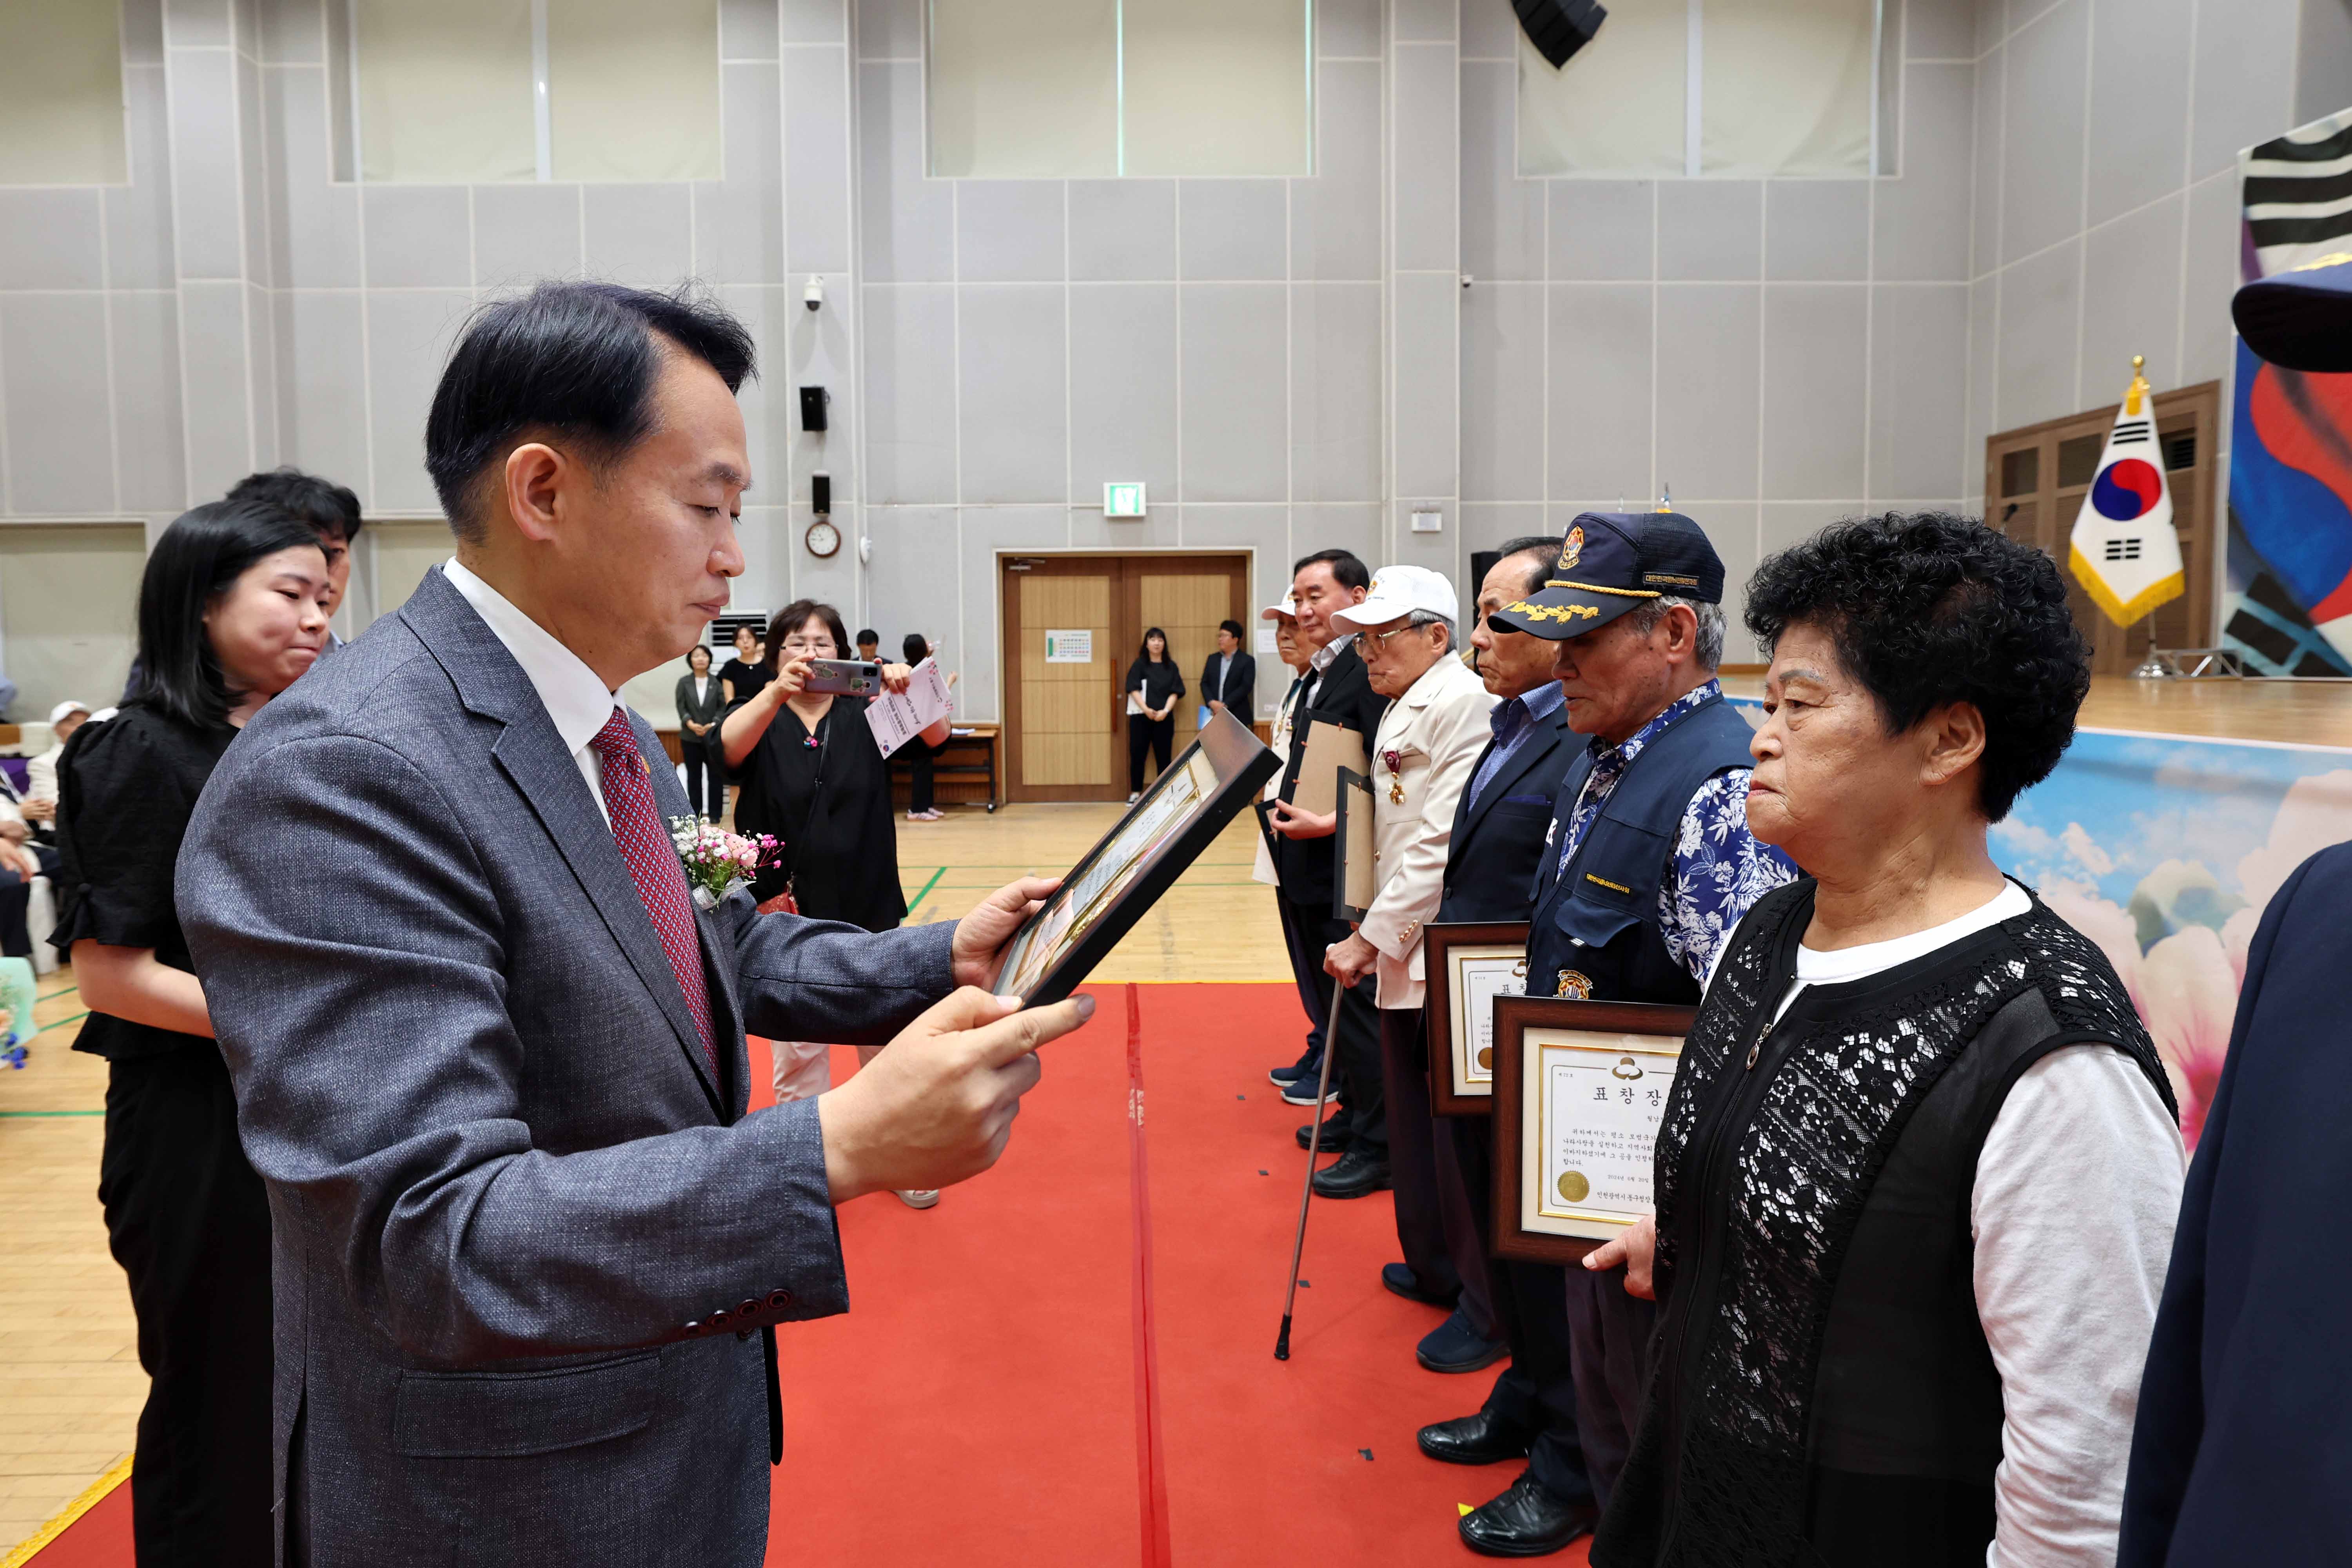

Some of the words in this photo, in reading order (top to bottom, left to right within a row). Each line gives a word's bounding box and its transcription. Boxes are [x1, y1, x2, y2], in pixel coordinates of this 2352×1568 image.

[1572, 1129, 1606, 1138] 귀하께서는
[1563, 1138, 1594, 1147] 나라사랑을
[1627, 1143, 1652, 1152] 지역사회
[1563, 1148, 1606, 1158] 이바지하셨기에
[1563, 1158, 1584, 1167] 합니다.
[1597, 1191, 1626, 1201] 인천광역시
[1627, 1195, 1651, 1203] 동구청장
